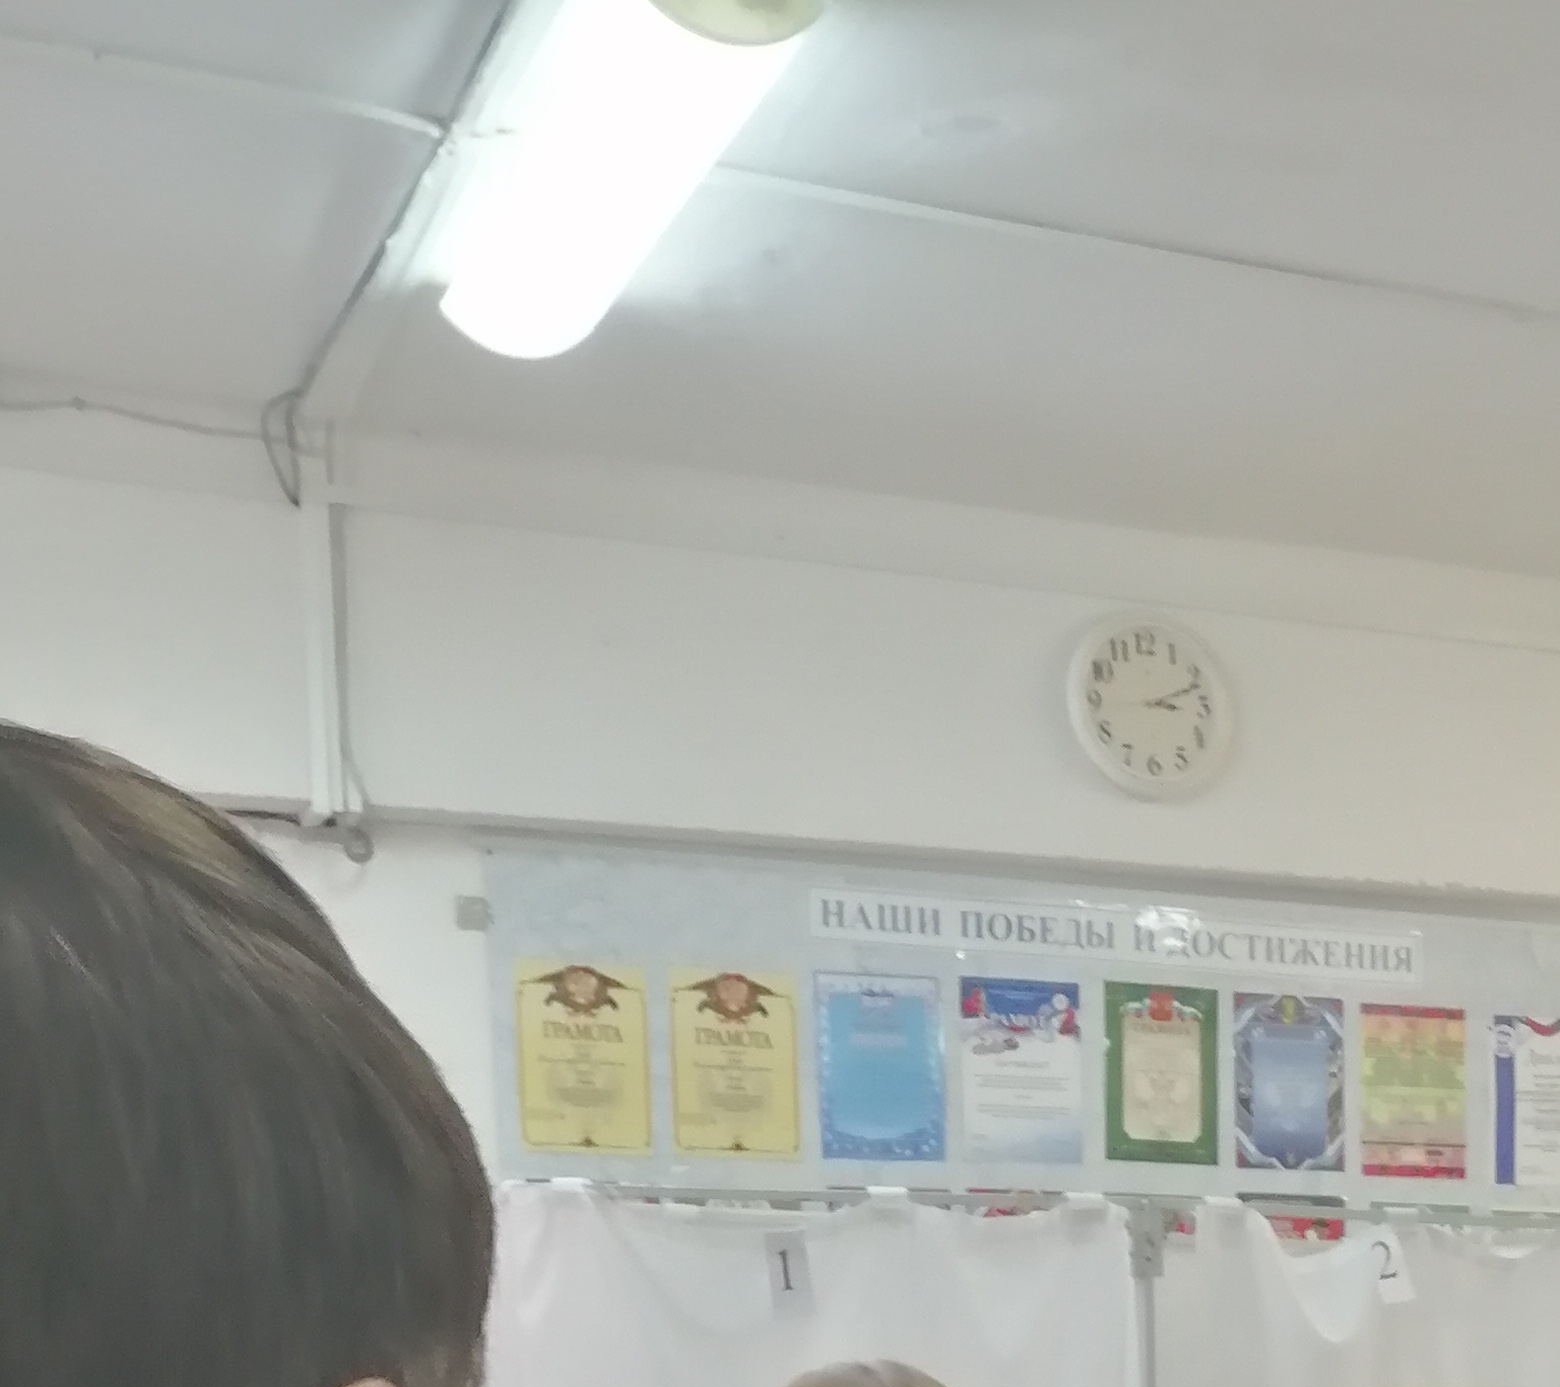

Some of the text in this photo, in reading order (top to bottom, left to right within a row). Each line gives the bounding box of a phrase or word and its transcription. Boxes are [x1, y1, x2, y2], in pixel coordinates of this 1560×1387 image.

[1110, 638, 1130, 662] 11
[1135, 633, 1156, 657] 12
[1168, 643, 1177, 665] 1
[1092, 660, 1115, 684] 10
[821, 898, 942, 936] НАШИ
[960, 909, 1116, 949] ПОБЕДЫ
[1133, 922, 1156, 952] И
[778, 1248, 794, 1291] 1
[1370, 1239, 1399, 1281] 2
